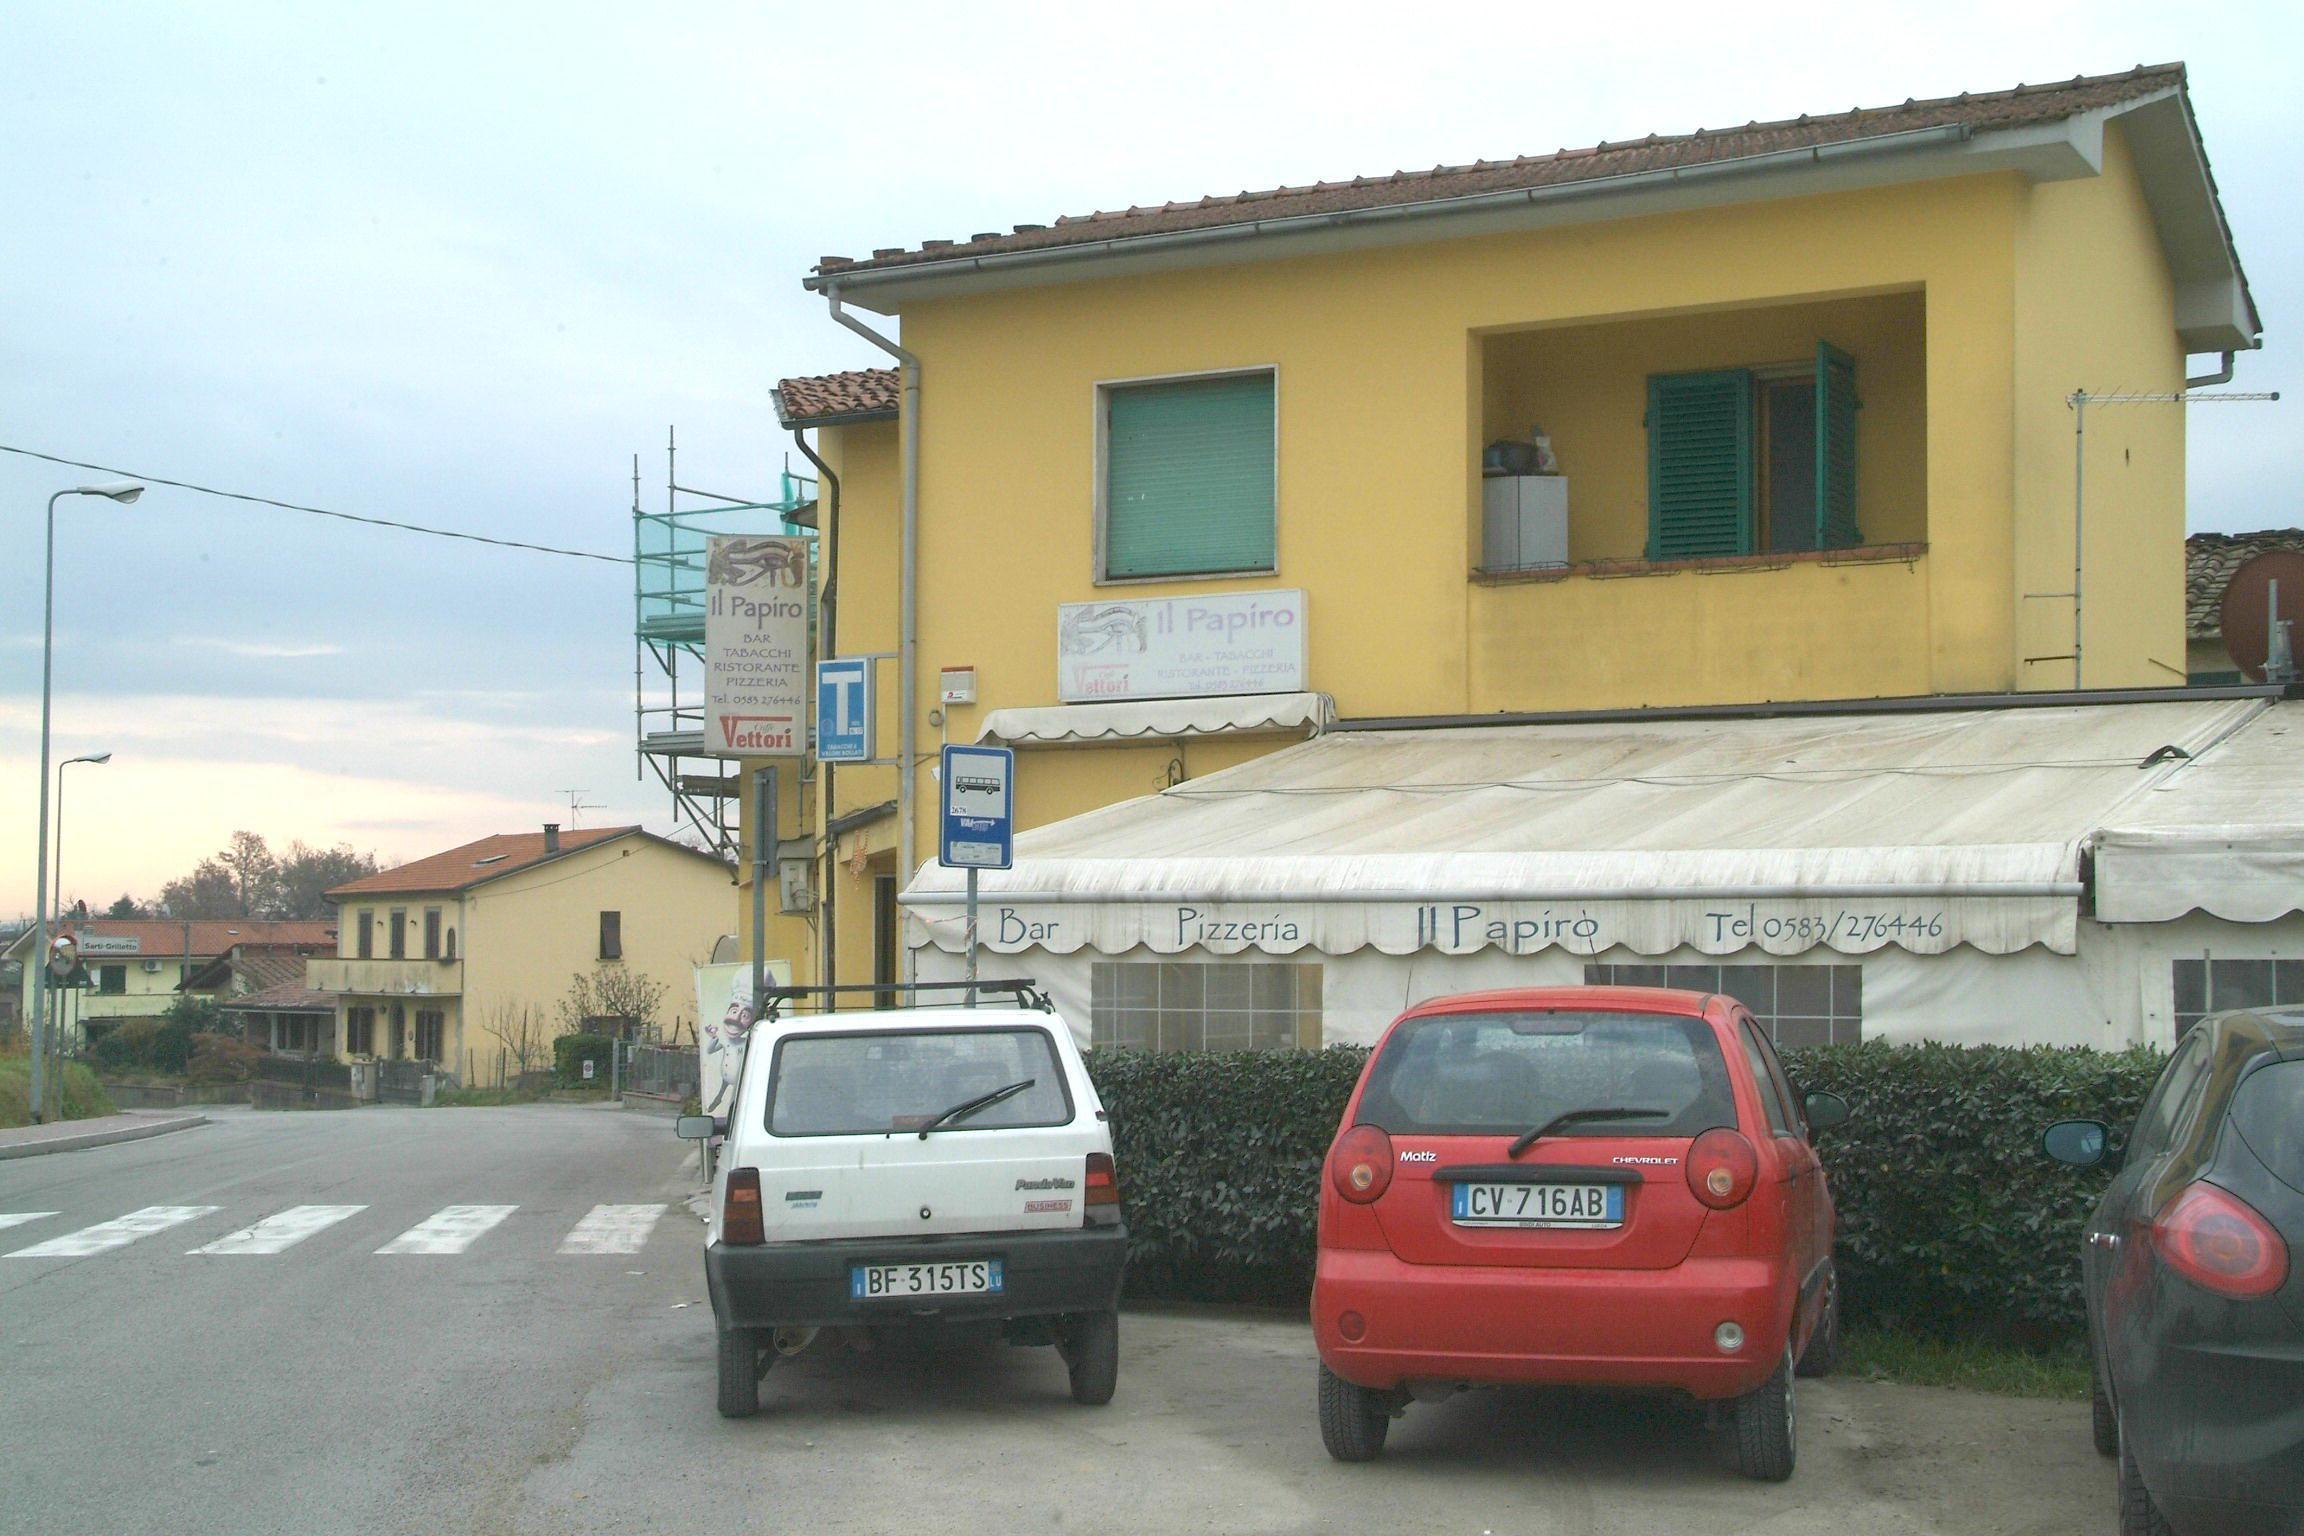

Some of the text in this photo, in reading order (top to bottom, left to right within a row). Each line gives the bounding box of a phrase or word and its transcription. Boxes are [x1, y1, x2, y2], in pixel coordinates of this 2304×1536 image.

[711, 588, 802, 631] Il Papiro
[1157, 602, 1294, 643] Il Papiro
[743, 633, 772, 644] BAR
[723, 648, 792, 658] TABACCHI
[713, 662, 800, 673] RISTORANTE
[1157, 663, 1296, 679] RISTORANTE PIZZERIA
[726, 677, 788, 687] PIZZERIA
[822, 670, 862, 736] T
[719, 715, 792, 748] Vettori
[998, 902, 1943, 953] Bar Pizzeria Il Papiro Tel 0583/276446
[1400, 1151, 1437, 1162] Matiz
[1612, 1156, 1679, 1165] CHEVROLET
